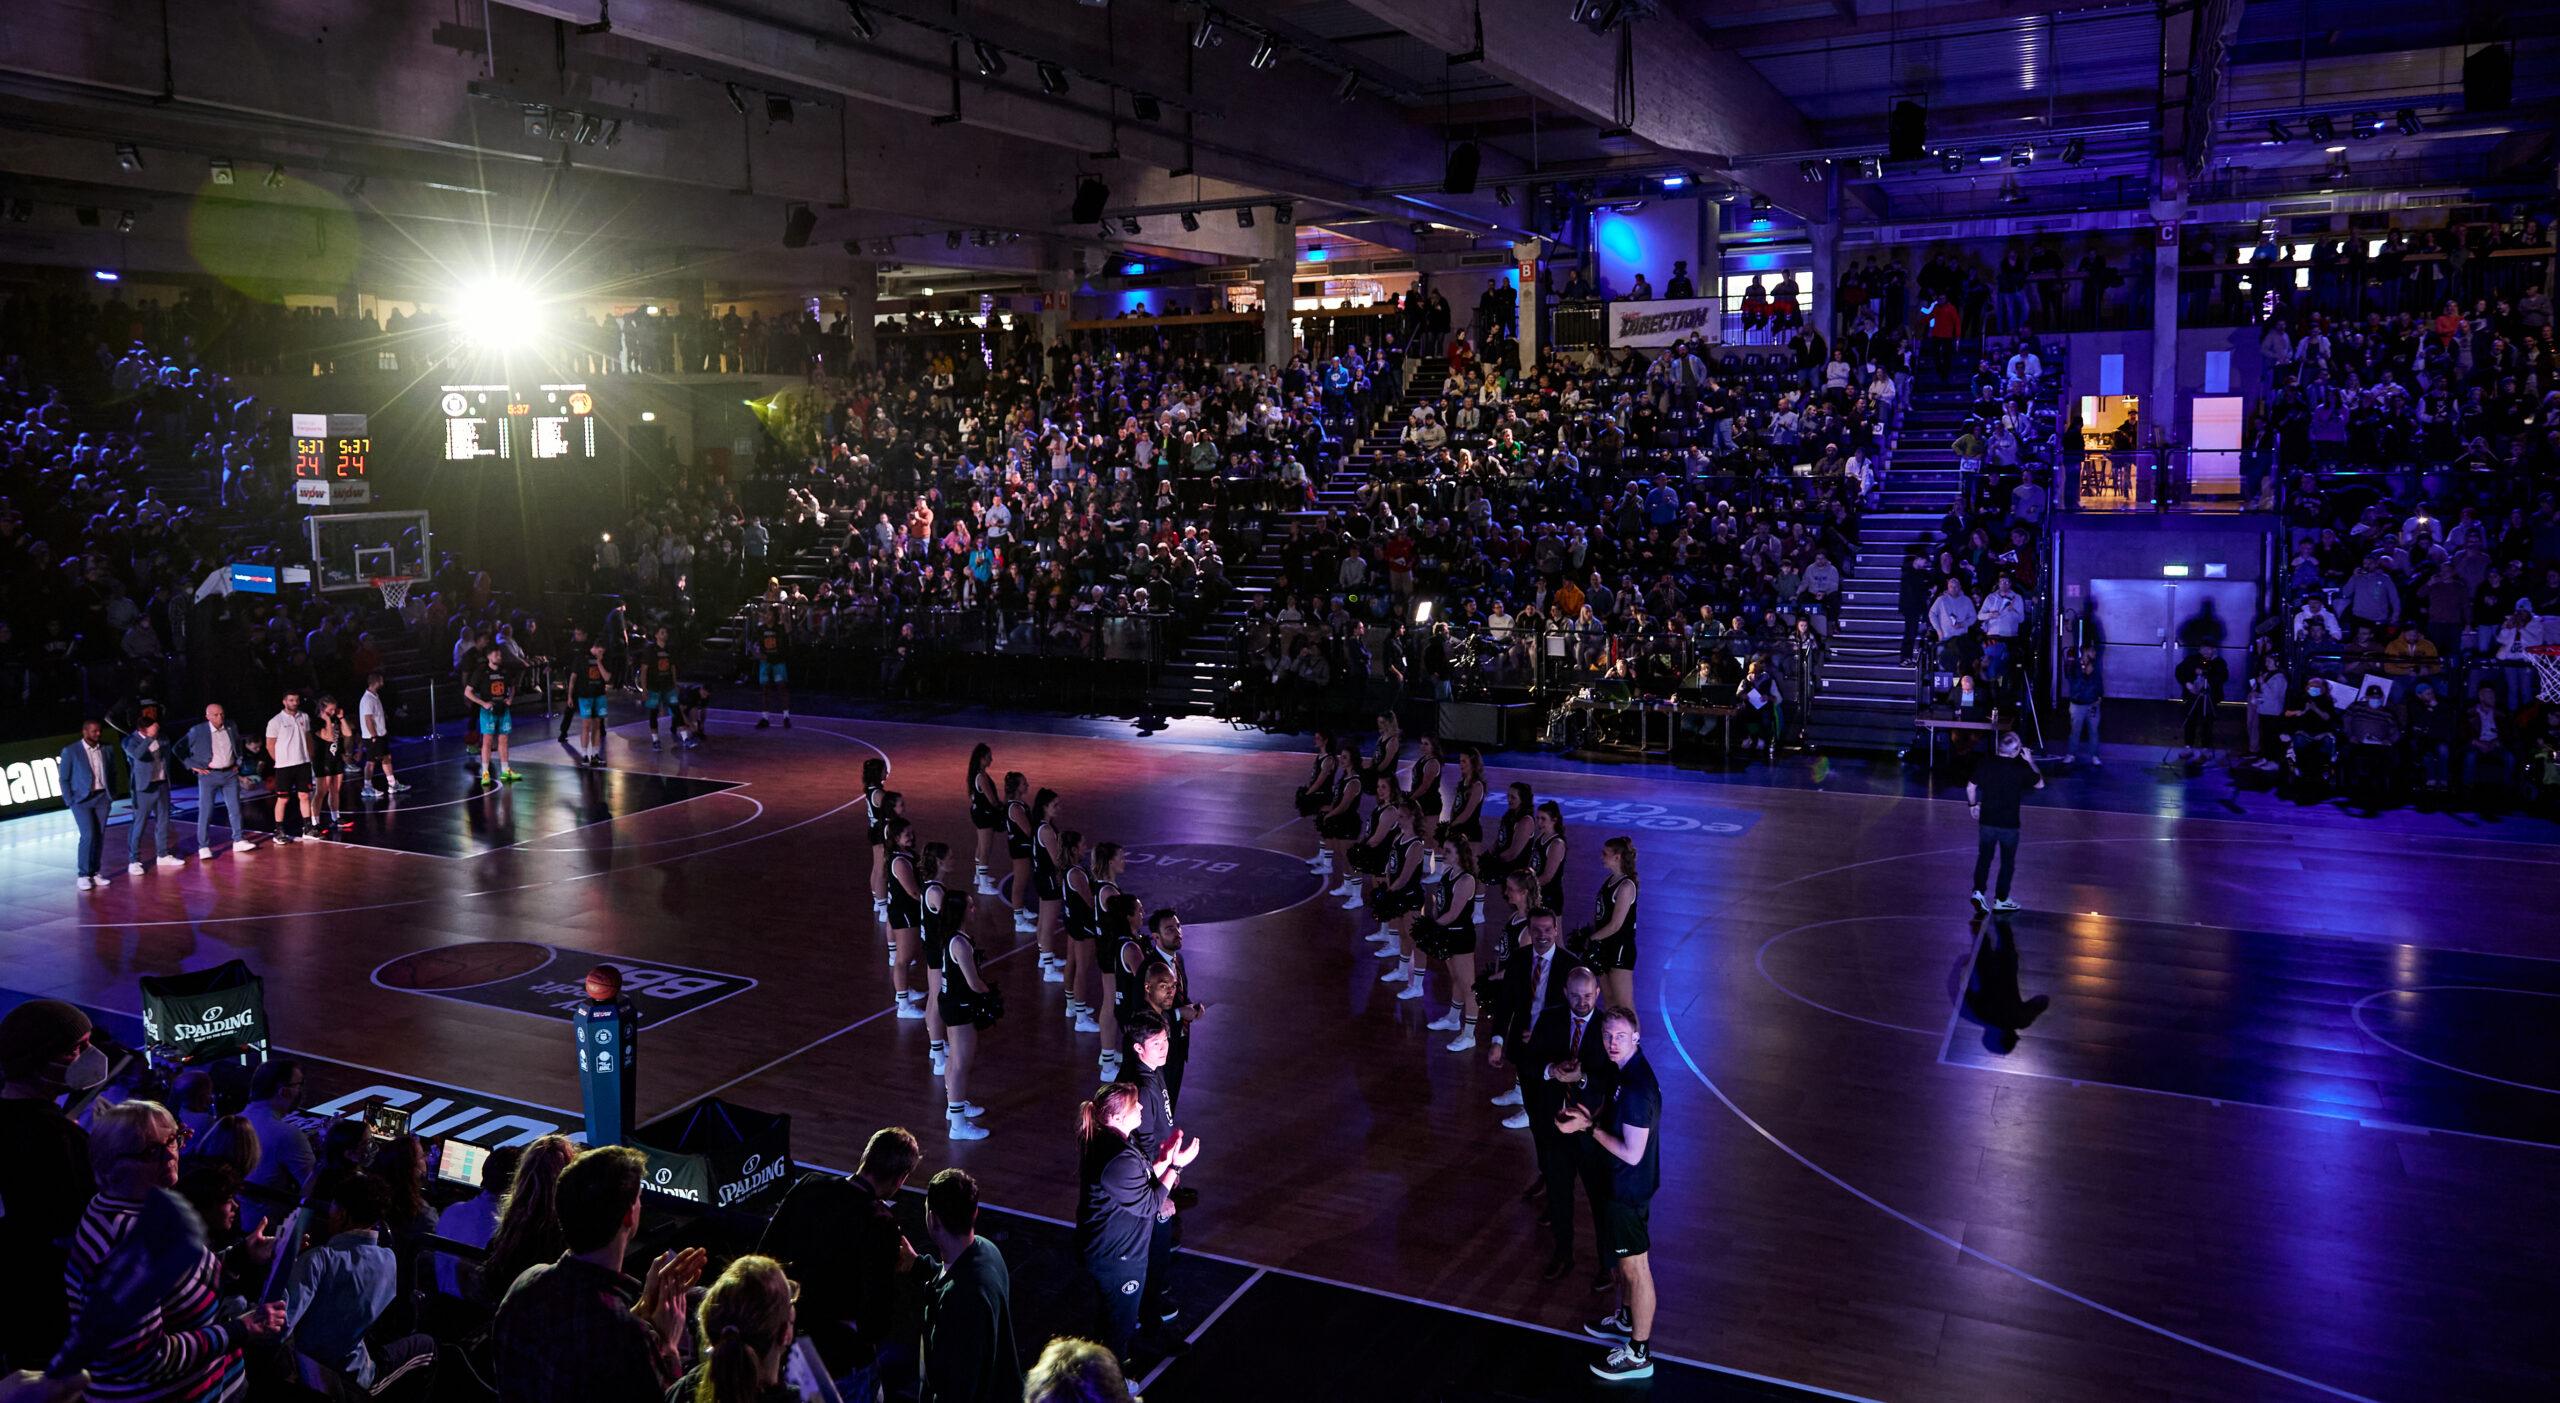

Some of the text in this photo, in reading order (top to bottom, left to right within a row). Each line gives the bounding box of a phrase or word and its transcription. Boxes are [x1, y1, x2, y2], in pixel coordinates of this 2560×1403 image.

[2162, 226, 2173, 240] C
[1522, 264, 1532, 277] B
[1619, 307, 1709, 338] DIRECTION
[508, 404, 530, 415] 5:37
[298, 440, 324, 454] 5:37
[339, 440, 370, 454] 5:37
[296, 456, 319, 476] 24
[337, 456, 364, 476] 24
[1124, 851, 1241, 873] BLAC
[174, 1008, 255, 1041] SPALDING
[718, 1155, 786, 1208] SPALDING
